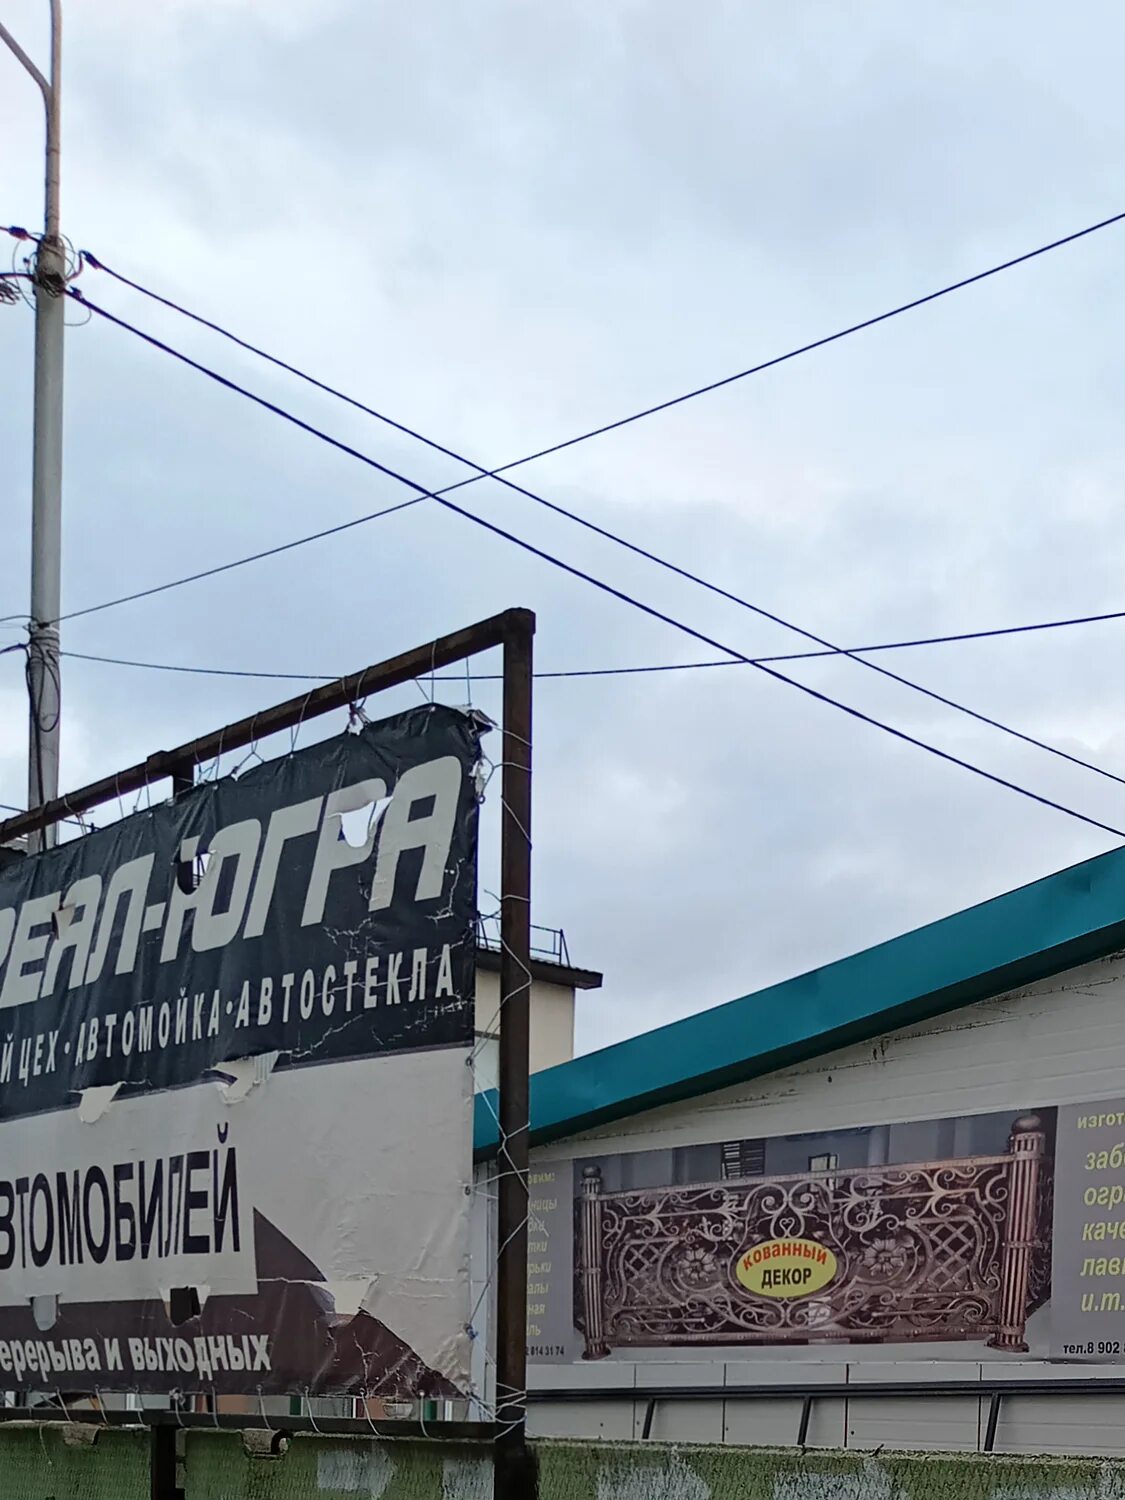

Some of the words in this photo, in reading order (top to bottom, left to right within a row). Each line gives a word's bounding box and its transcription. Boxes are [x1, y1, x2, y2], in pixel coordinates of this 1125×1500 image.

[18, 1029, 60, 1087] ЦЕХ
[75, 986, 220, 1067] АВТОМОЙКА
[235, 943, 456, 1028] АВТОСТЕКЛА
[742, 1243, 828, 1272] кованный
[761, 1268, 813, 1290] ДЕКОР
[128, 1334, 273, 1382] выходных
[1097, 1341, 1120, 1354] 902
